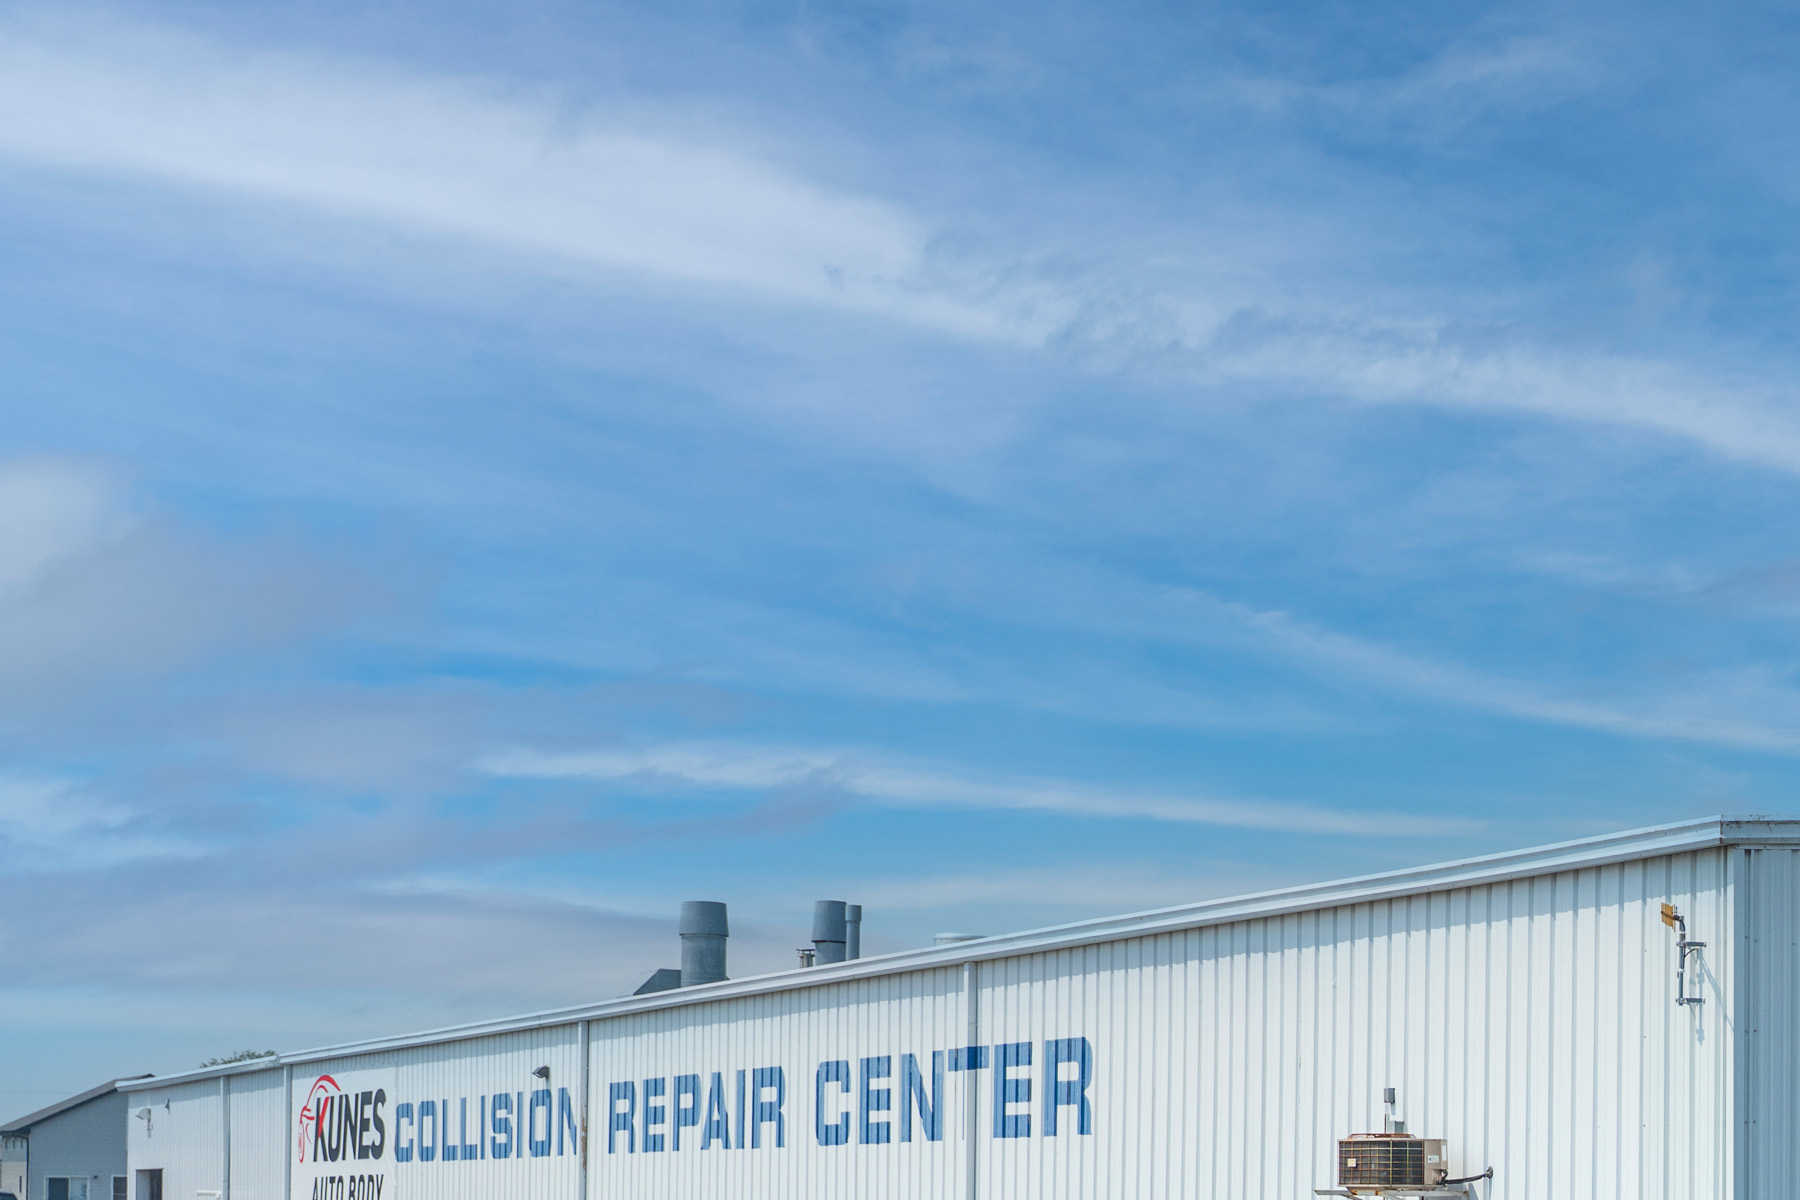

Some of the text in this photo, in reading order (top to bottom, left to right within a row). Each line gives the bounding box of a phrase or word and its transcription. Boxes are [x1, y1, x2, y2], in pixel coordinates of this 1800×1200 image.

[313, 1088, 387, 1163] KUNES
[395, 1087, 577, 1163] COLLISION
[608, 1066, 786, 1154] REPAIR
